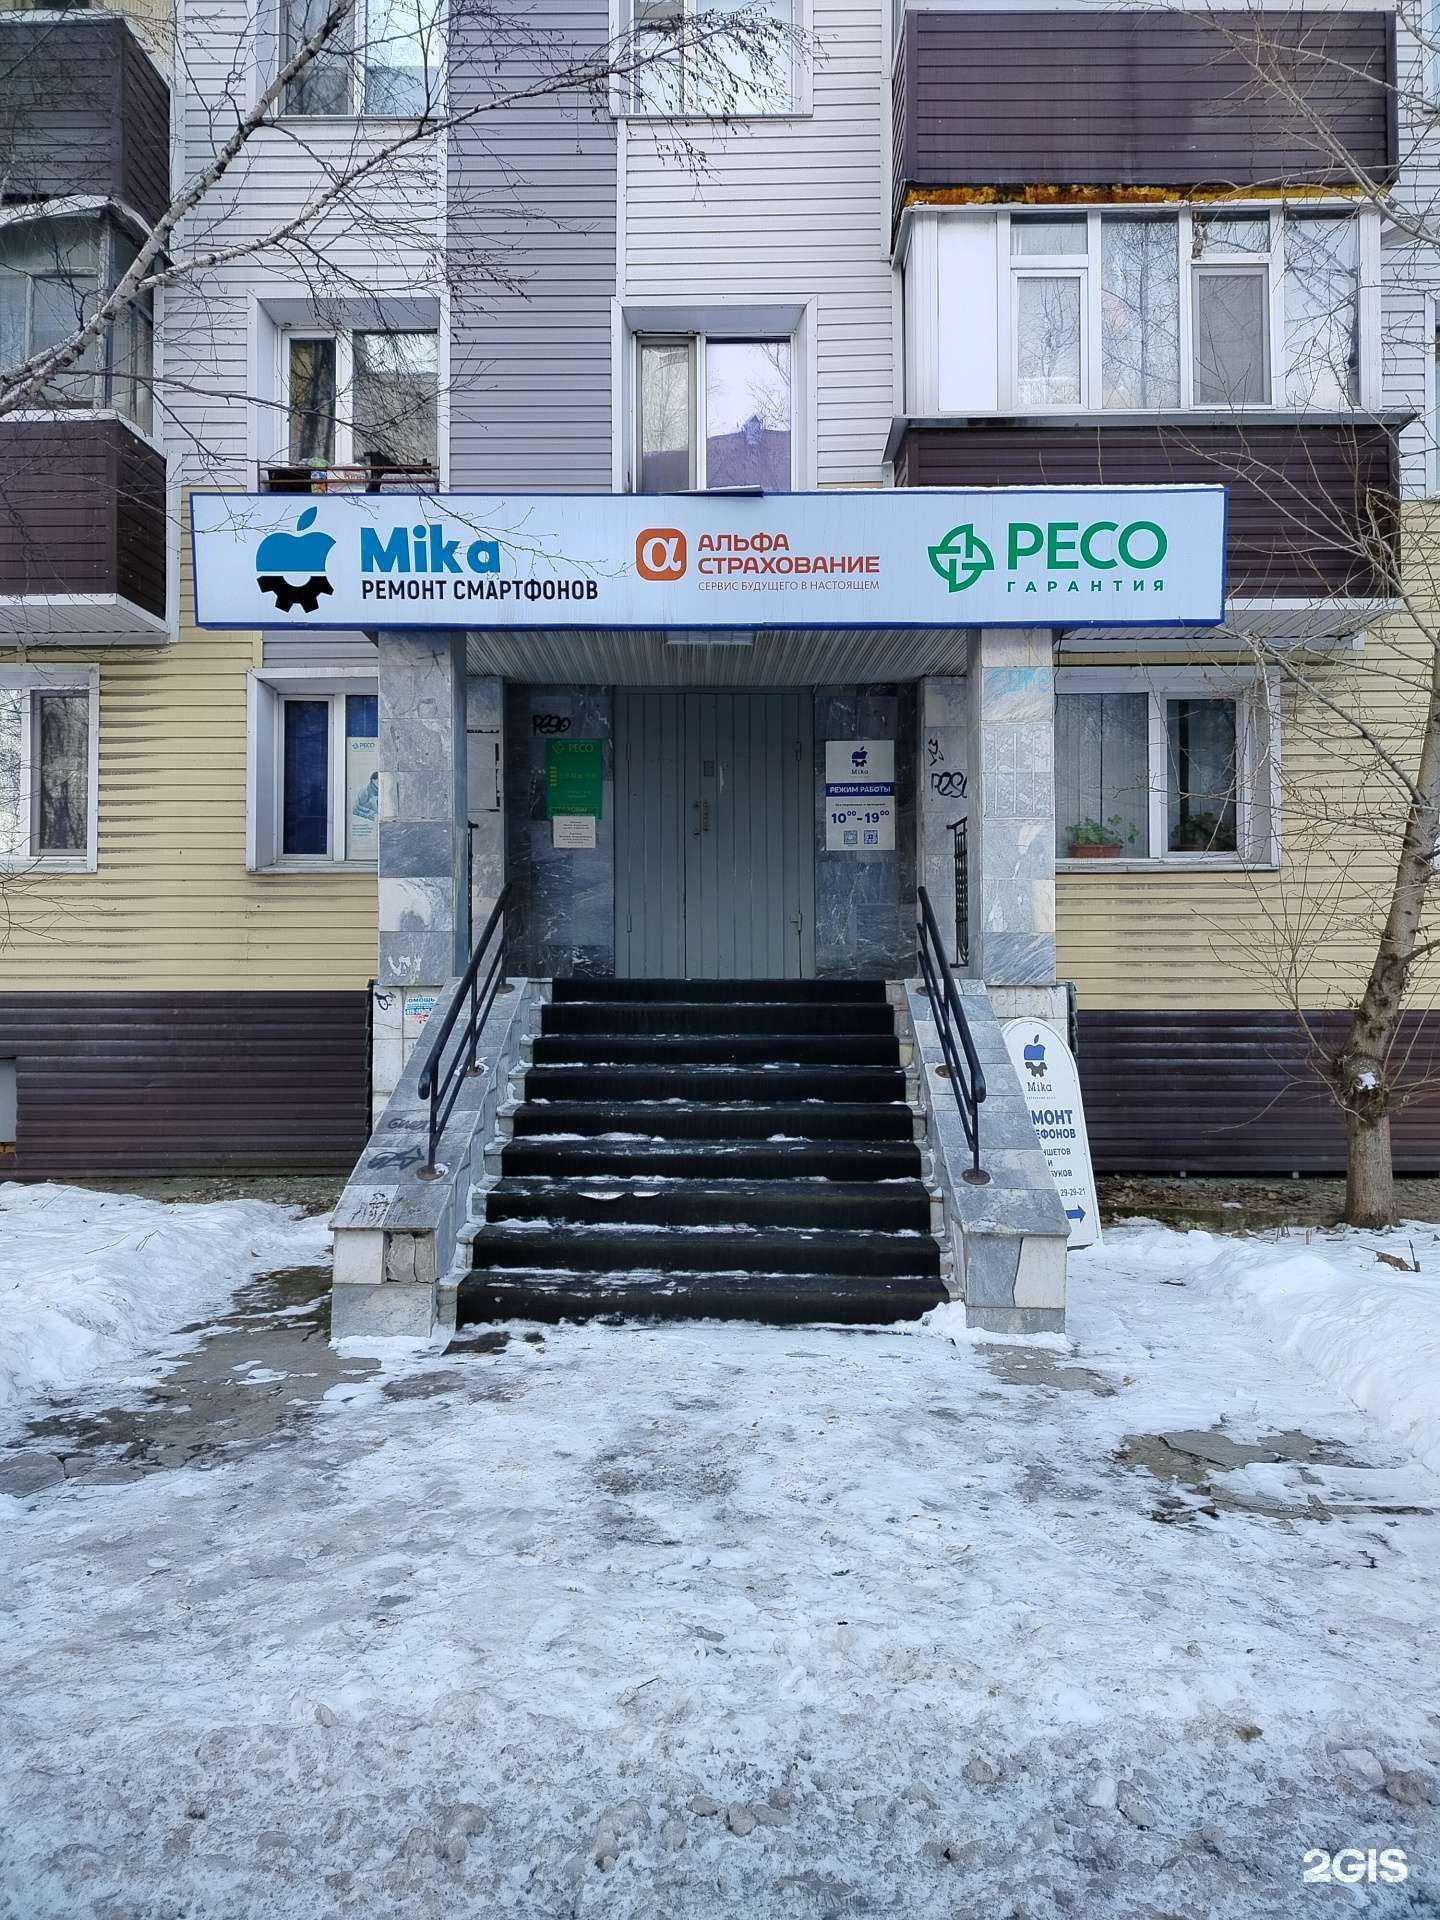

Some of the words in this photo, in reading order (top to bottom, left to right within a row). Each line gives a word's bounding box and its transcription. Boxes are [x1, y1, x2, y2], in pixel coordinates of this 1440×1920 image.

[360, 524, 501, 574] Mika
[698, 532, 790, 553] АЛЬФА
[1007, 521, 1168, 570] РЕСО
[698, 556, 880, 574] СТРАХОВАНИЕ
[362, 579, 447, 600] РЕМОНТ
[453, 579, 598, 601] СМАРТФОНОВ
[698, 581, 739, 591] СЕРВИС
[741, 581, 799, 592] БУДУЩЕГО
[801, 581, 808, 591] В
[810, 580, 880, 592] НАСТОЯЩЕМ
[1007, 580, 1164, 592] ГАРАНТИЯ
[568, 744, 594, 752] РЕСО
[860, 785, 891, 793] РАБОТЫ
[1027, 1082, 1052, 1092] Mika
[1030, 1109, 1072, 1125] МОНТ
[1047, 1159, 1053, 1167] И
